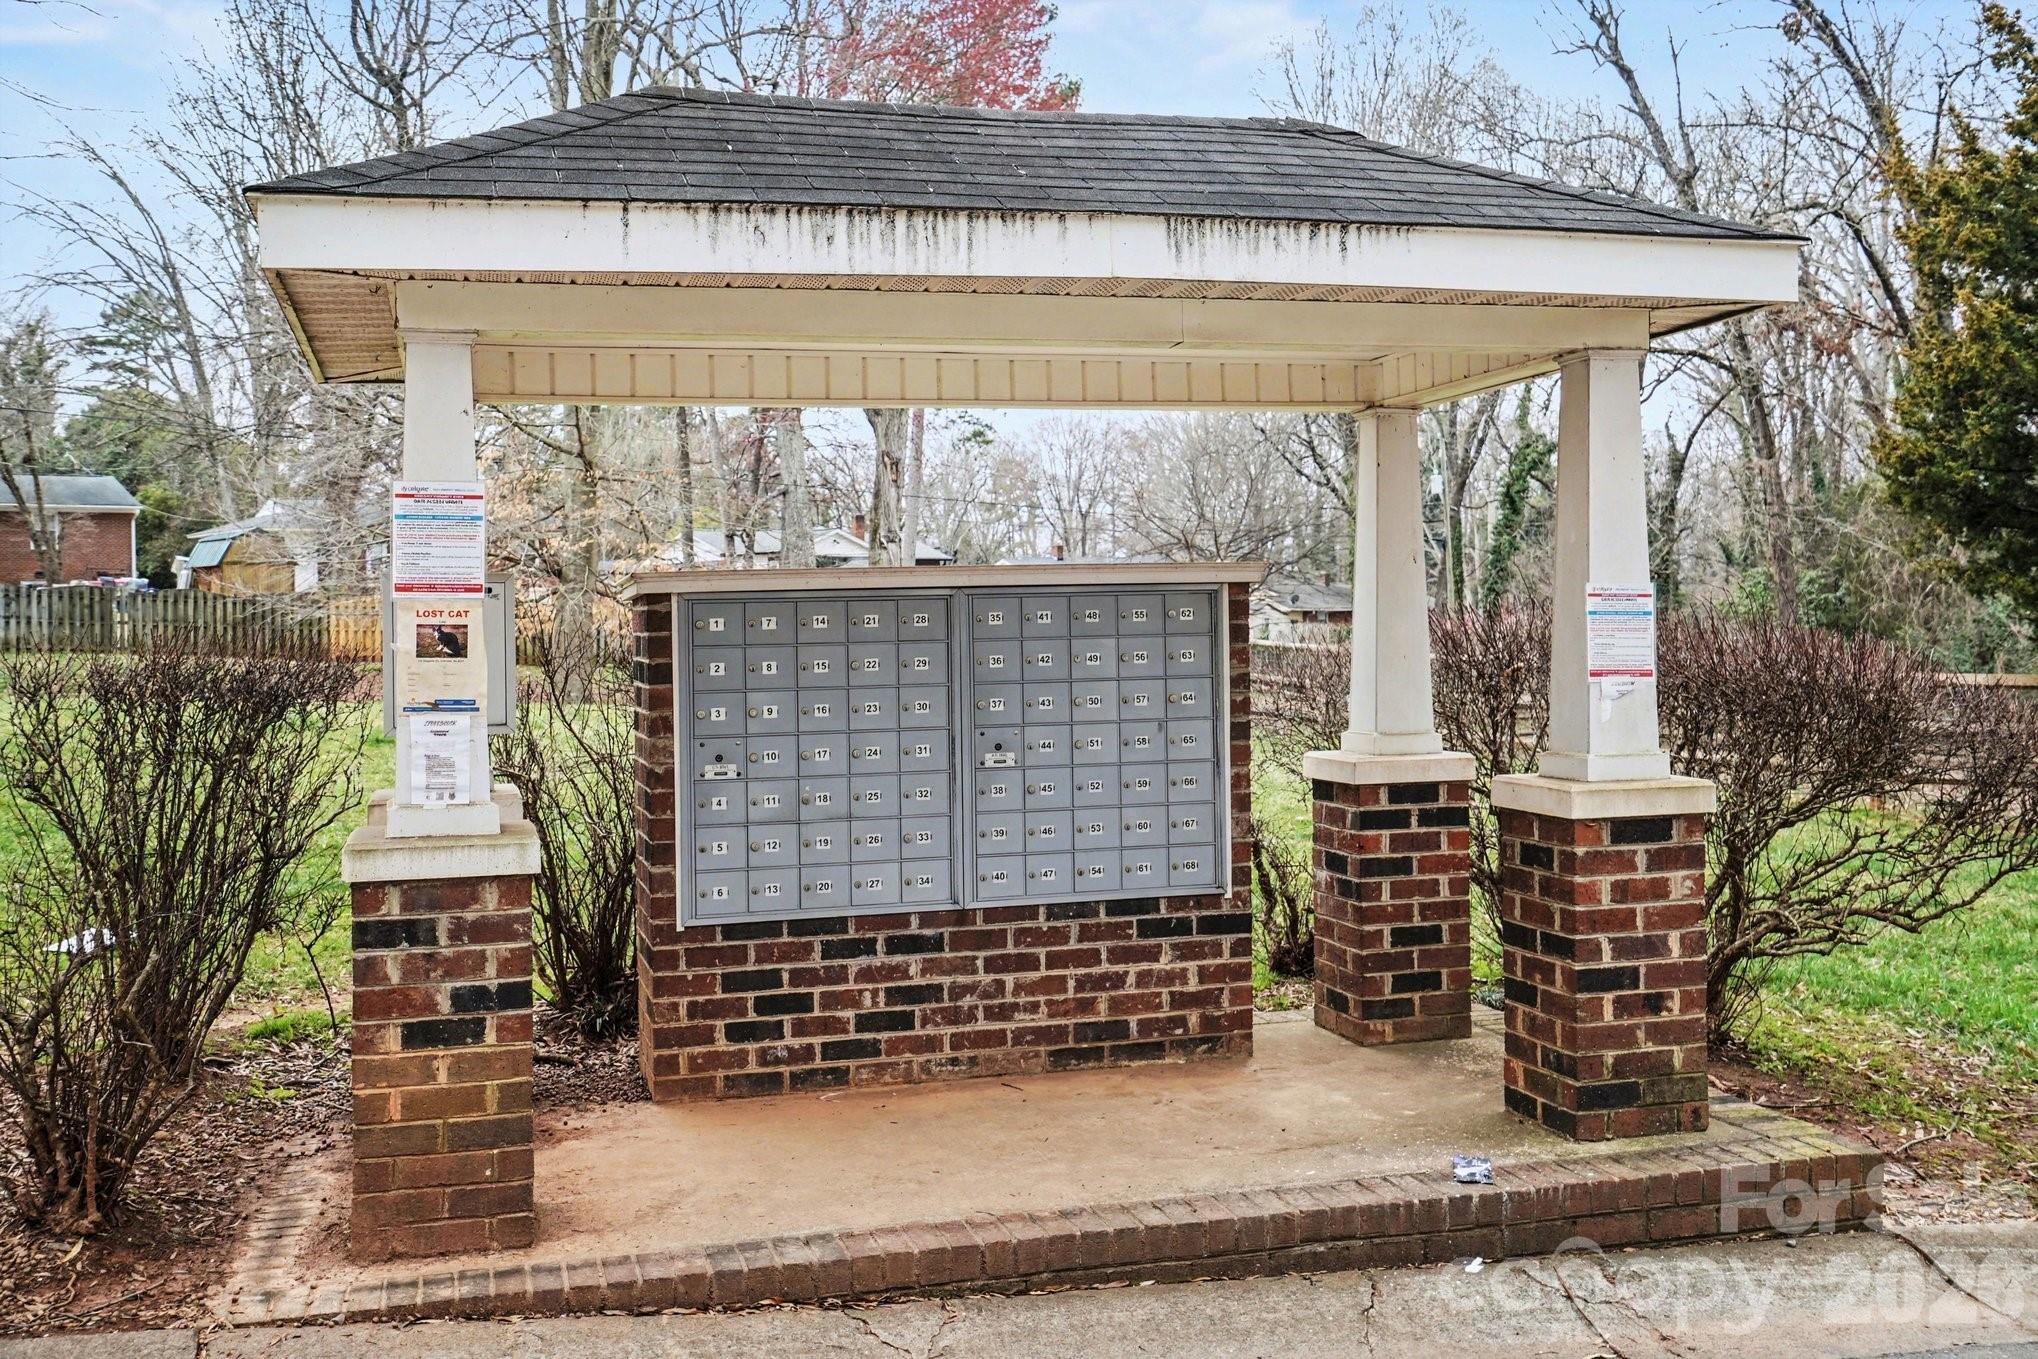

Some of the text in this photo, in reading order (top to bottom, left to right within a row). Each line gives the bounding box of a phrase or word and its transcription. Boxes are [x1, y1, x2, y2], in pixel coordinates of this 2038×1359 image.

[416, 609, 470, 618] LOST CAT
[990, 613, 1002, 622] 35
[1038, 612, 1049, 621] 41
[1086, 611, 1098, 620] 48
[1134, 610, 1145, 619] 55
[1181, 609, 1192, 618] 62
[713, 619, 719, 629] 1
[765, 618, 772, 628] 7
[814, 616, 826, 626] 14
[865, 616, 876, 626] 21
[915, 615, 927, 624] 28
[1039, 655, 1051, 664] 42
[1087, 654, 1099, 663] 49
[1135, 652, 1146, 662] 56
[1181, 651, 1193, 660] 63
[815, 661, 827, 671] 15
[865, 660, 877, 669] 22
[915, 658, 927, 668] 29
[990, 656, 1002, 666] 36
[714, 664, 721, 673] 2
[766, 663, 773, 672] 8
[1039, 698, 1052, 707] 43
[1088, 696, 1100, 706] 50
[1135, 694, 1147, 704] 57
[1182, 693, 1194, 702] 64
[866, 703, 878, 713] 23
[916, 702, 928, 711] 30
[991, 699, 1003, 709] 37
[714, 709, 721, 719] 3
[766, 707, 774, 716] 9
[816, 705, 828, 715] 16
[1040, 741, 1052, 749] 44
[1089, 739, 1099, 748] 51
[1136, 737, 1148, 746] 58
[1182, 735, 1195, 745] 65
[816, 749, 828, 759] 17
[867, 748, 879, 757] 24
[917, 746, 928, 755] 31
[765, 751, 777, 761] 10
[1089, 781, 1101, 791] 52
[1137, 779, 1148, 788] 59
[1183, 777, 1195, 786] 66
[992, 786, 1004, 795] 38
[1041, 783, 1053, 793] 45
[817, 794, 829, 803] 18
[867, 791, 879, 801] 25
[917, 789, 929, 799] 32
[715, 798, 722, 807] 4
[765, 796, 776, 806] 11
[1090, 823, 1102, 833] 53
[1137, 821, 1149, 831] 60
[1184, 819, 1196, 828] 67
[993, 828, 1005, 838] 39
[1041, 826, 1053, 836] 46
[868, 835, 880, 845] 26
[917, 832, 930, 842] 33
[717, 843, 723, 852] 5
[766, 840, 778, 850] 12
[818, 838, 829, 847] 19
[1138, 863, 1148, 873] 61
[1185, 861, 1196, 870] 68
[994, 871, 1006, 881] 40
[1042, 869, 1054, 878] 47
[1091, 866, 1102, 876] 54
[868, 879, 880, 889] 27
[918, 876, 931, 886] 34
[766, 884, 779, 894] 13
[818, 882, 830, 891] 20
[717, 888, 724, 898] 6
